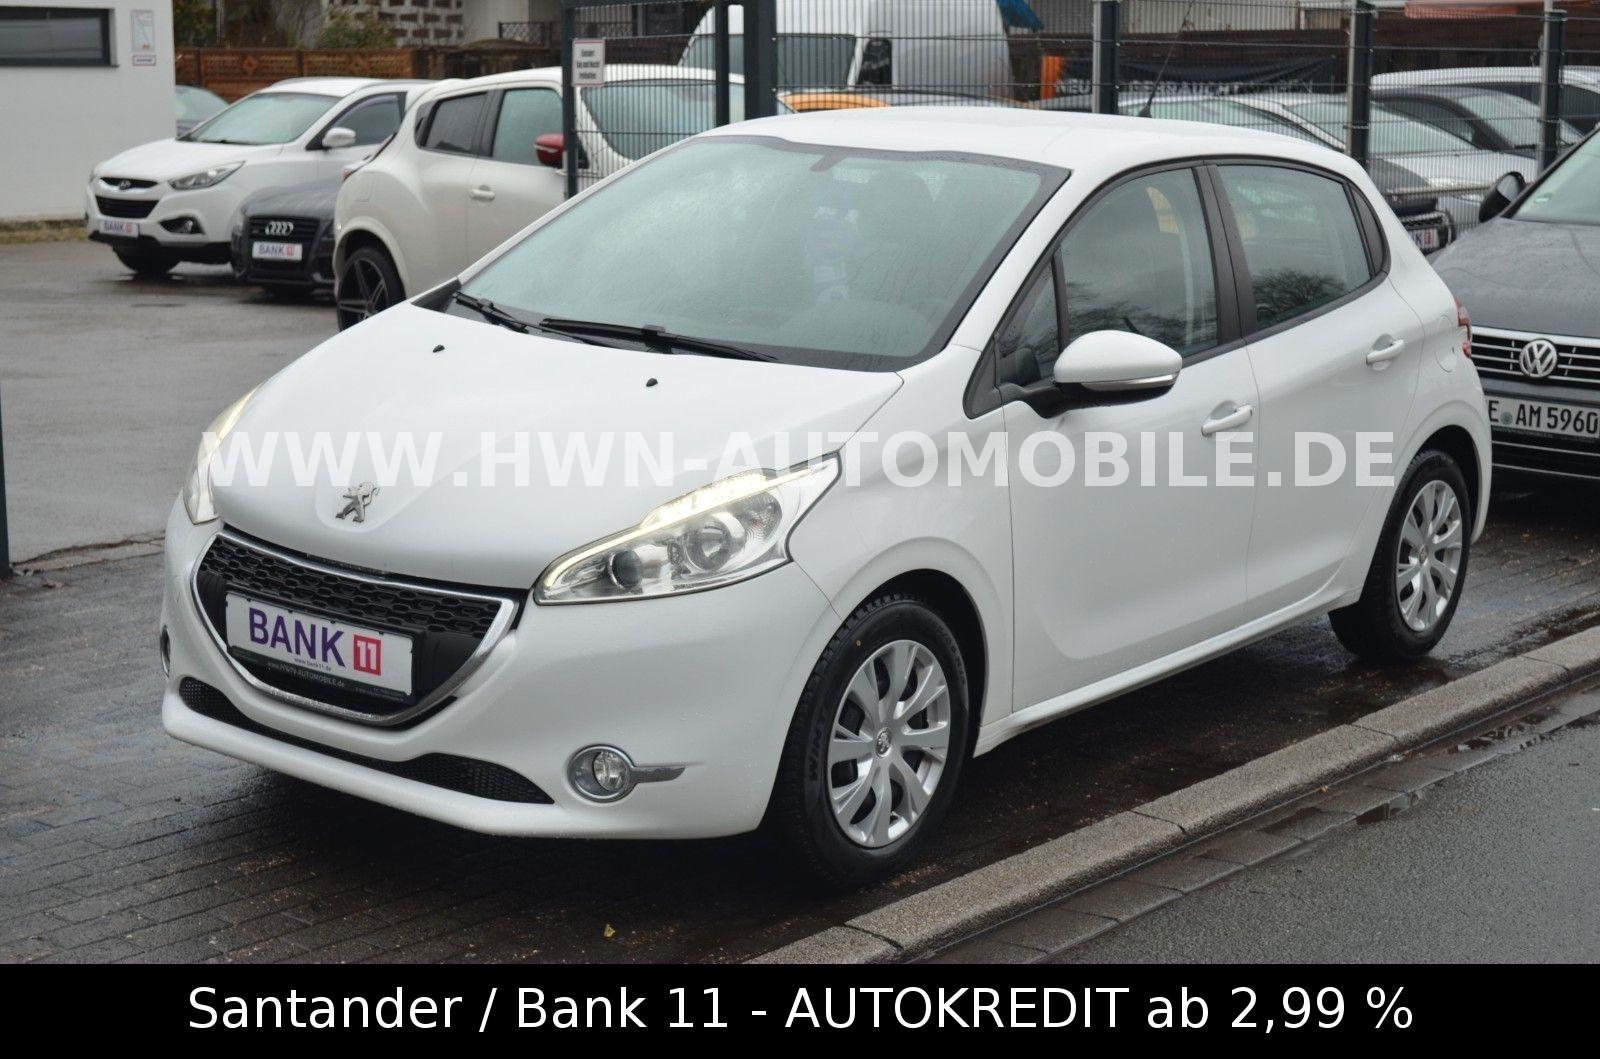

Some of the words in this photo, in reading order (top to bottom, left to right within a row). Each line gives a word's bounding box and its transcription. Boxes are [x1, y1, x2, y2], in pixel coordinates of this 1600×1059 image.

[258, 244, 285, 256] BANK
[1515, 403, 1542, 427] AM
[1547, 406, 1598, 434] 5960
[249, 606, 345, 668] BANK
[355, 637, 379, 672] 11
